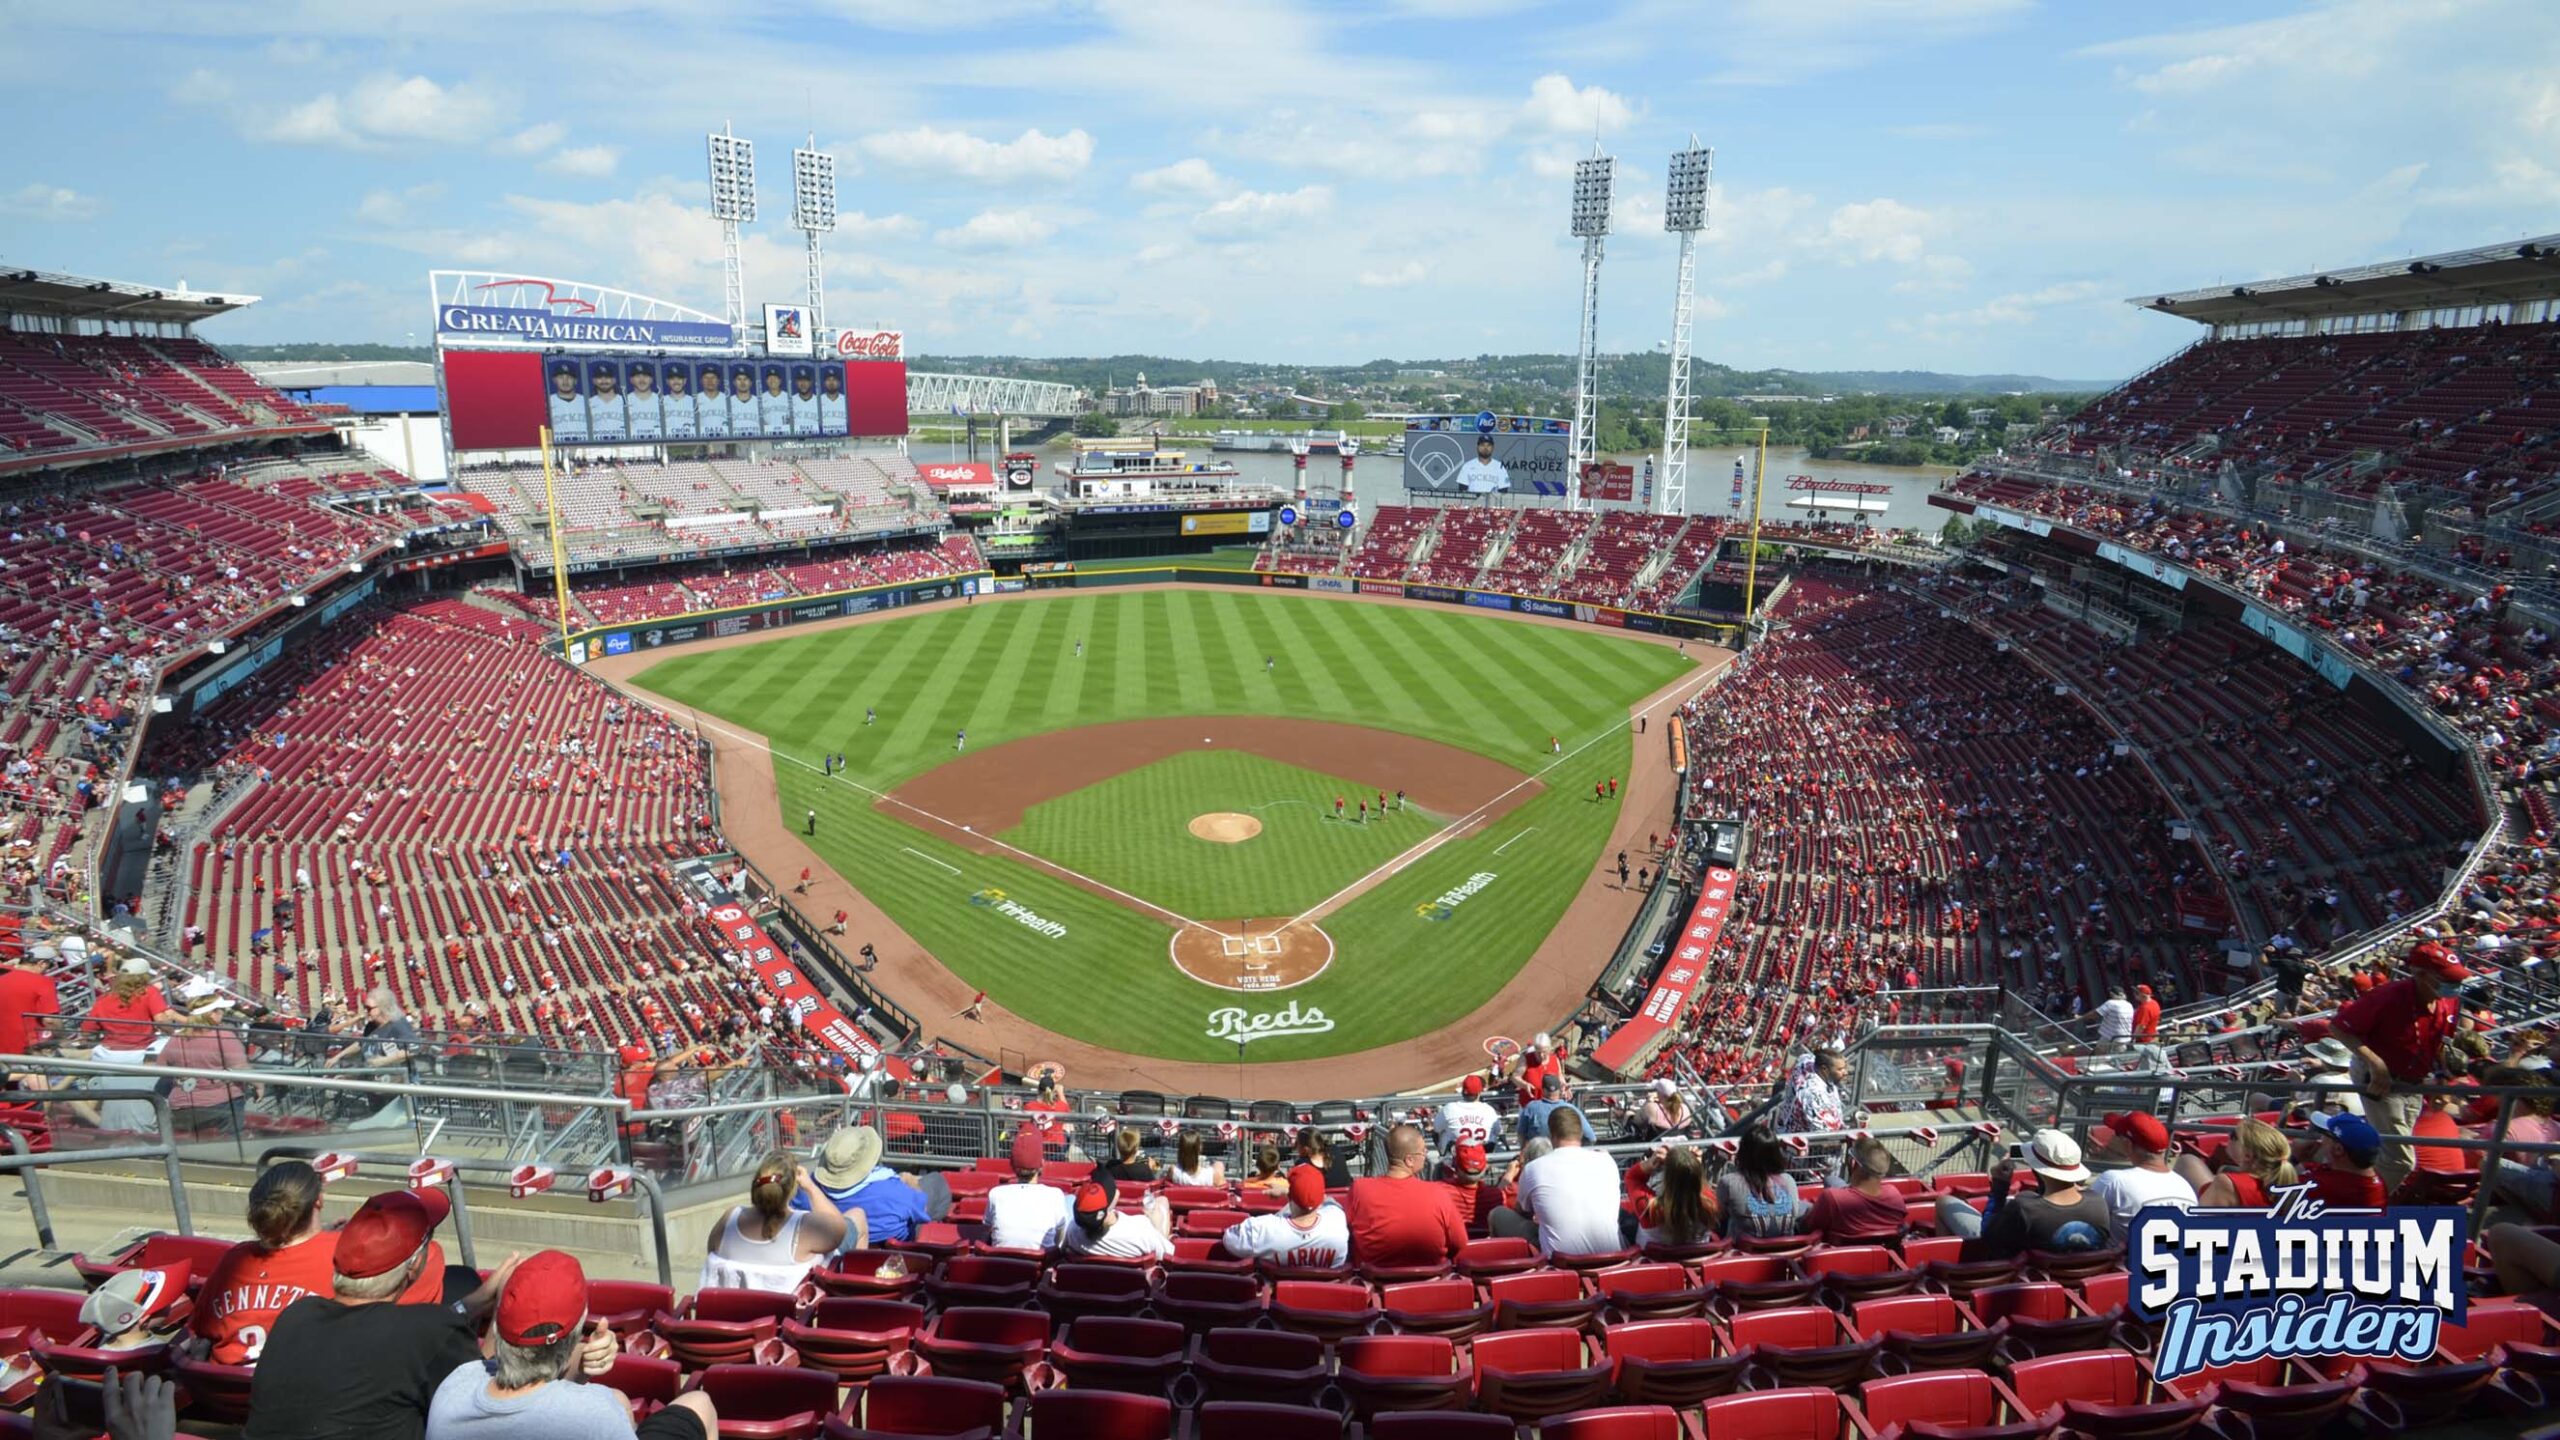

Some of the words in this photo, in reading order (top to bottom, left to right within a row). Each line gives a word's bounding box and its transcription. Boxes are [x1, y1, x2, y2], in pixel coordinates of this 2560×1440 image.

[444, 308, 537, 332] GREAT
[660, 335, 702, 344] INSURANCE
[704, 335, 728, 345] GROUP
[837, 330, 902, 356] Coca-Cola
[1479, 418, 1495, 427] P&G
[930, 466, 976, 480] Reds
[584, 562, 599, 571] PM
[1362, 585, 1402, 594] CRAFTSMAN
[1533, 602, 1565, 614] Staffmark
[1435, 872, 1498, 906] TriHealth
[996, 899, 1067, 939] TriHealth
[1237, 976, 1256, 984] VOTE
[1260, 975, 1281, 983] REDS
[1655, 989, 1683, 1024] CHAMPIONS
[831, 1018, 860, 1041] NATIONAL
[1205, 1000, 1336, 1044] Reds
[1459, 1114, 1484, 1126] BRUCE
[213, 1283, 320, 1319] GENNET
